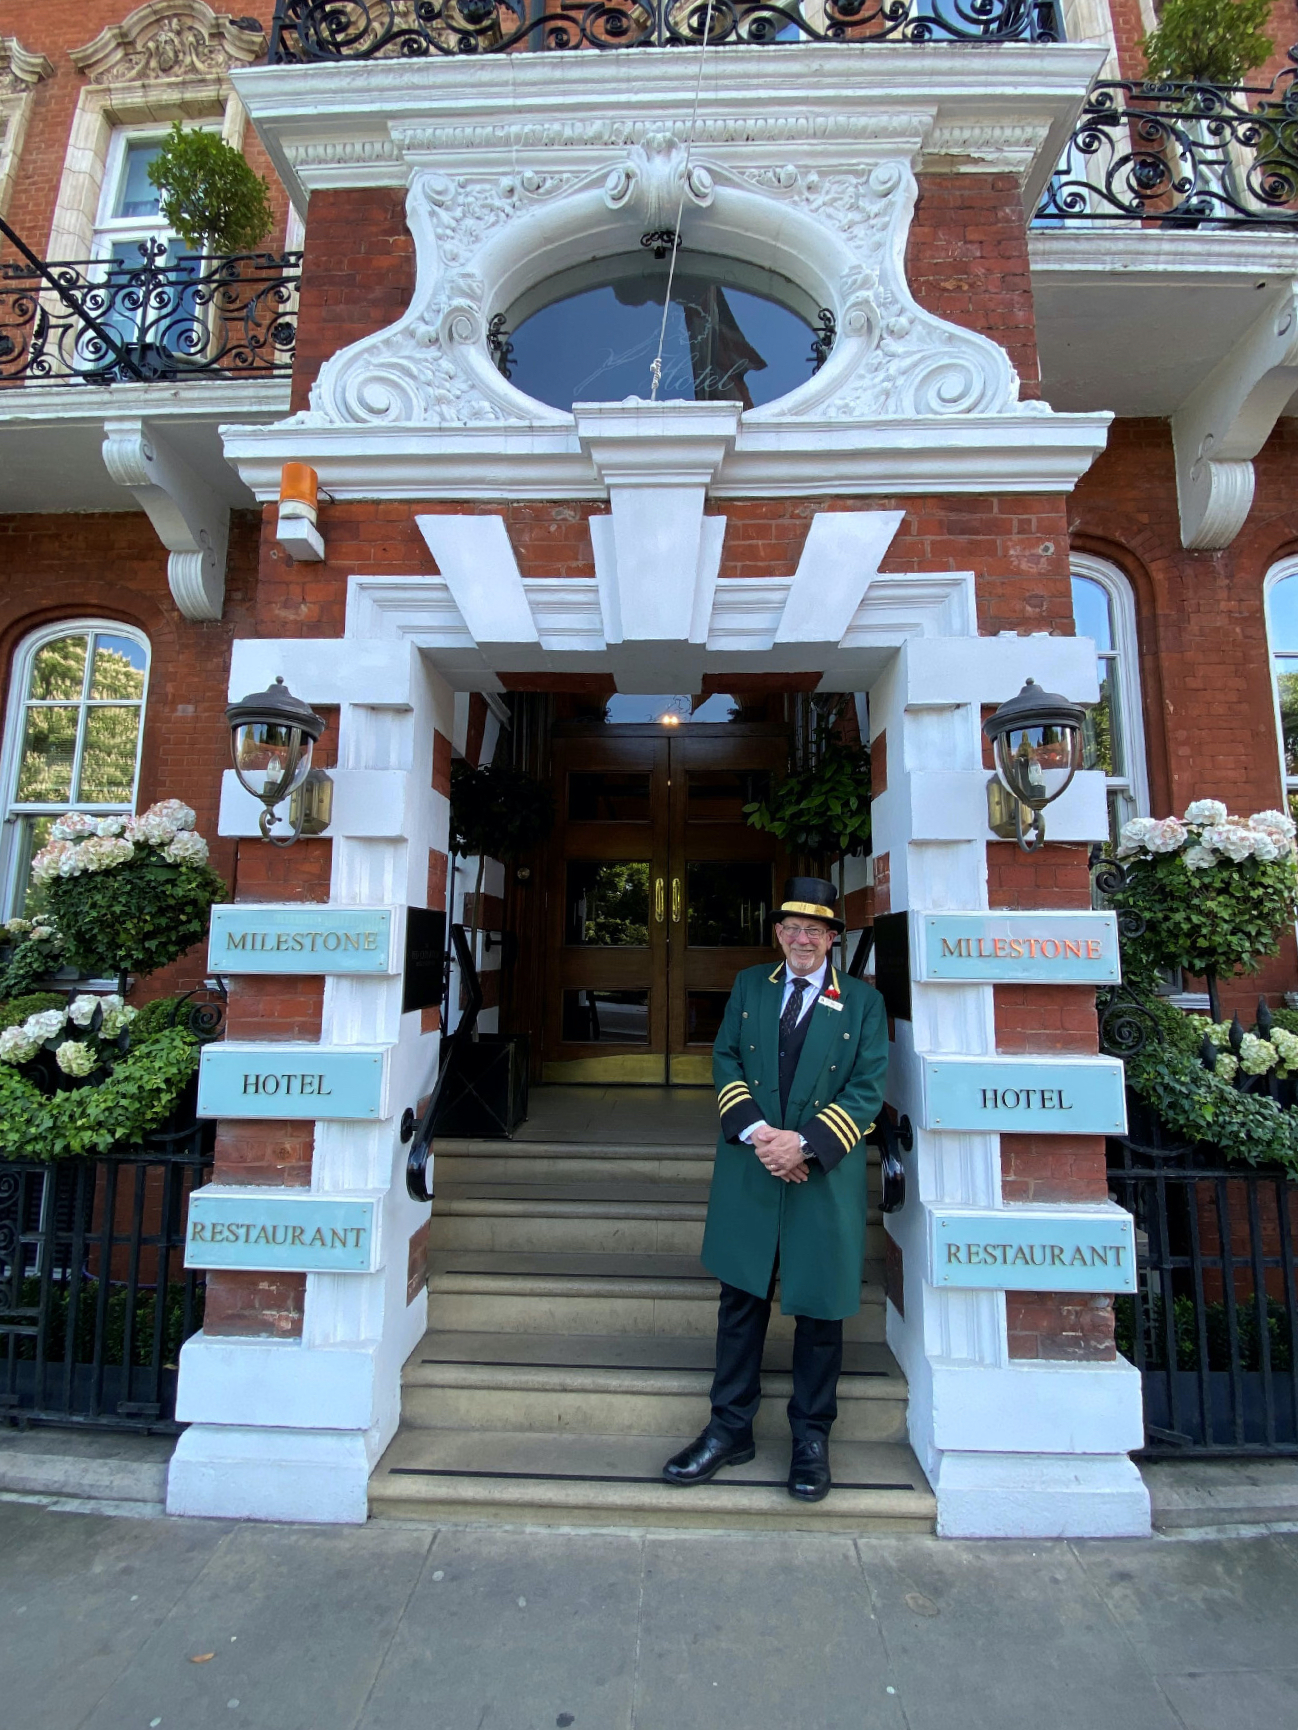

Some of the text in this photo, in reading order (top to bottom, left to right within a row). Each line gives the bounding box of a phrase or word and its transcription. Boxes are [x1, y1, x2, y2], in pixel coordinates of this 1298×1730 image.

[639, 352, 748, 392] Hotel
[227, 931, 379, 951] MILESTONE
[941, 937, 1102, 960] MILESTONE
[242, 1074, 332, 1095] HOTEL
[981, 1088, 1073, 1110] HOTEL
[190, 1221, 366, 1249] RESTAURANT
[947, 1243, 1126, 1267] RESTAURANT
